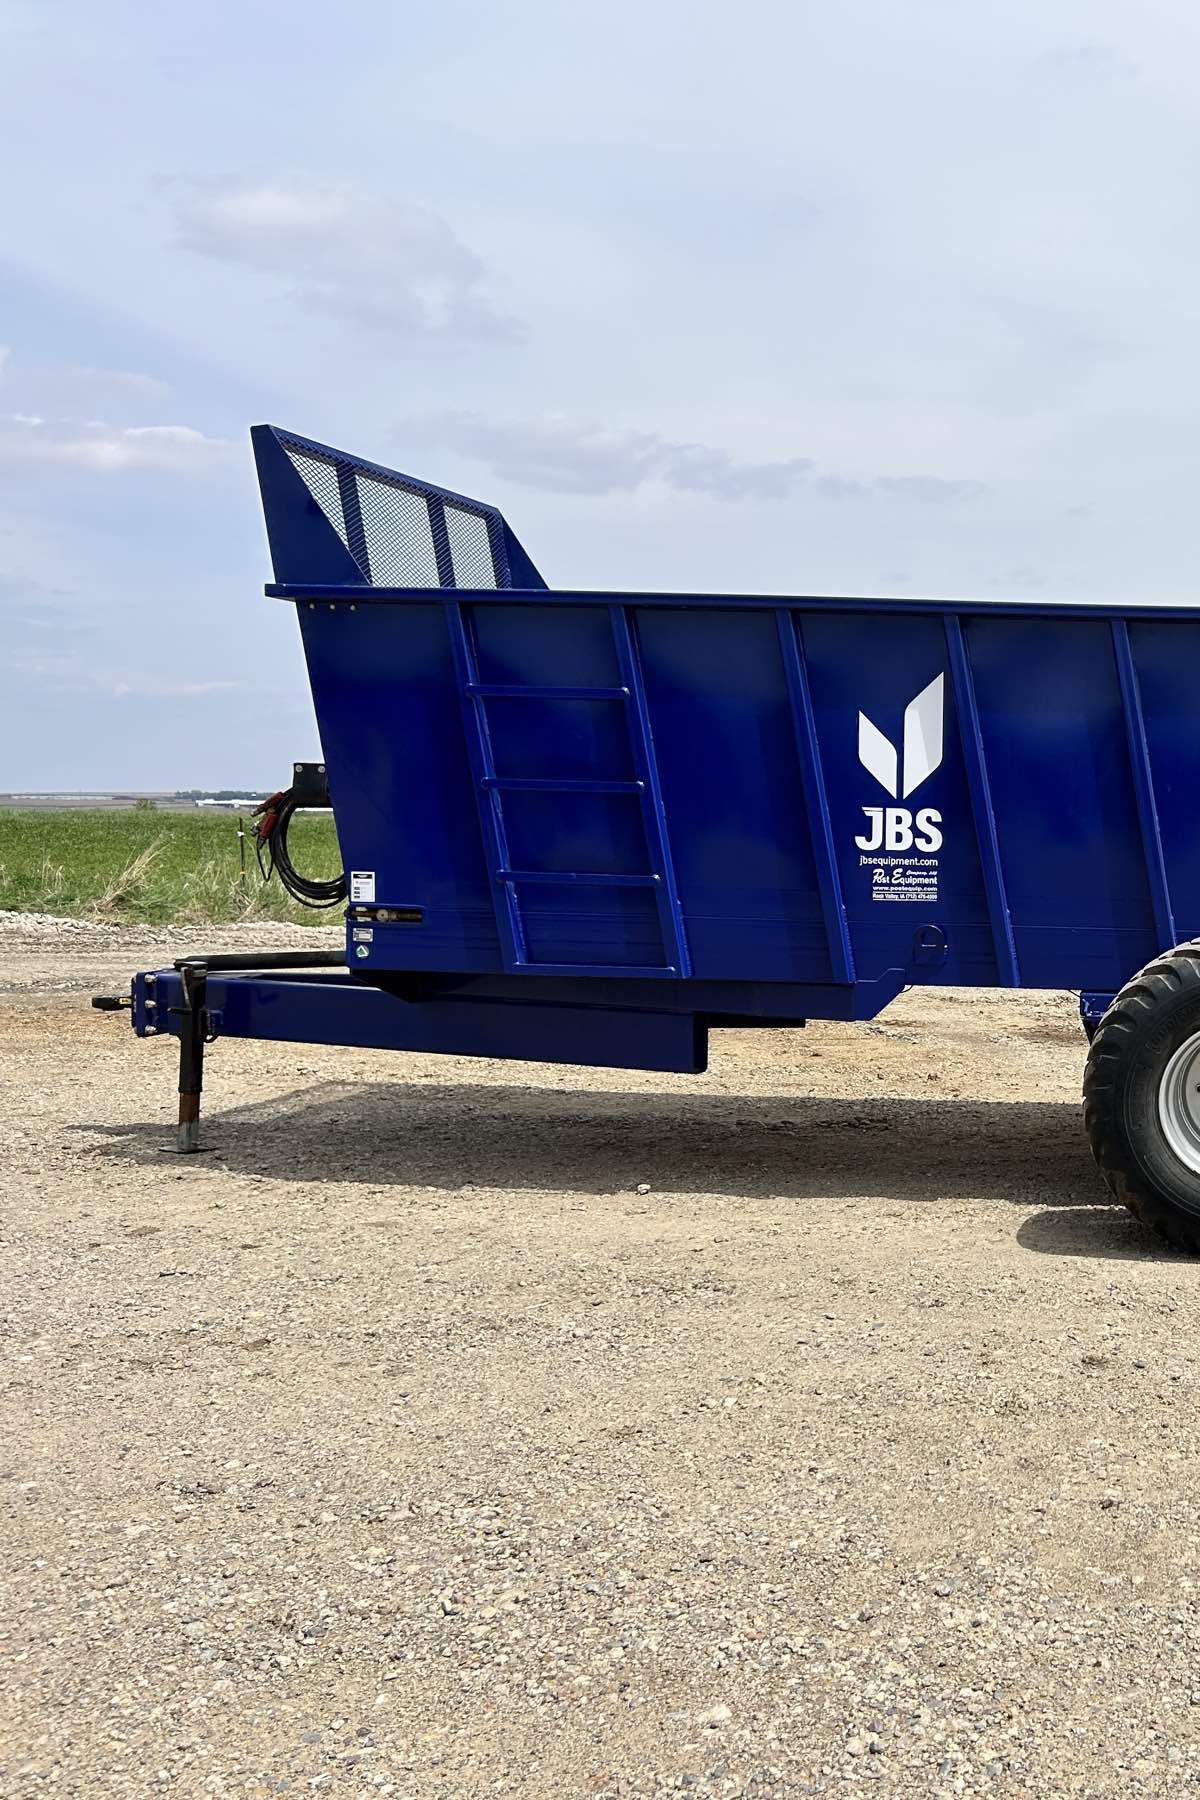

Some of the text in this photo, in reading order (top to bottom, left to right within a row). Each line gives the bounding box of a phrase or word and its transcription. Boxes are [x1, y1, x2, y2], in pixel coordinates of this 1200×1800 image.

[855, 807, 943, 852] JBS
[860, 856, 938, 866] jbsequipment.com
[892, 868, 938, 885] Equipment
